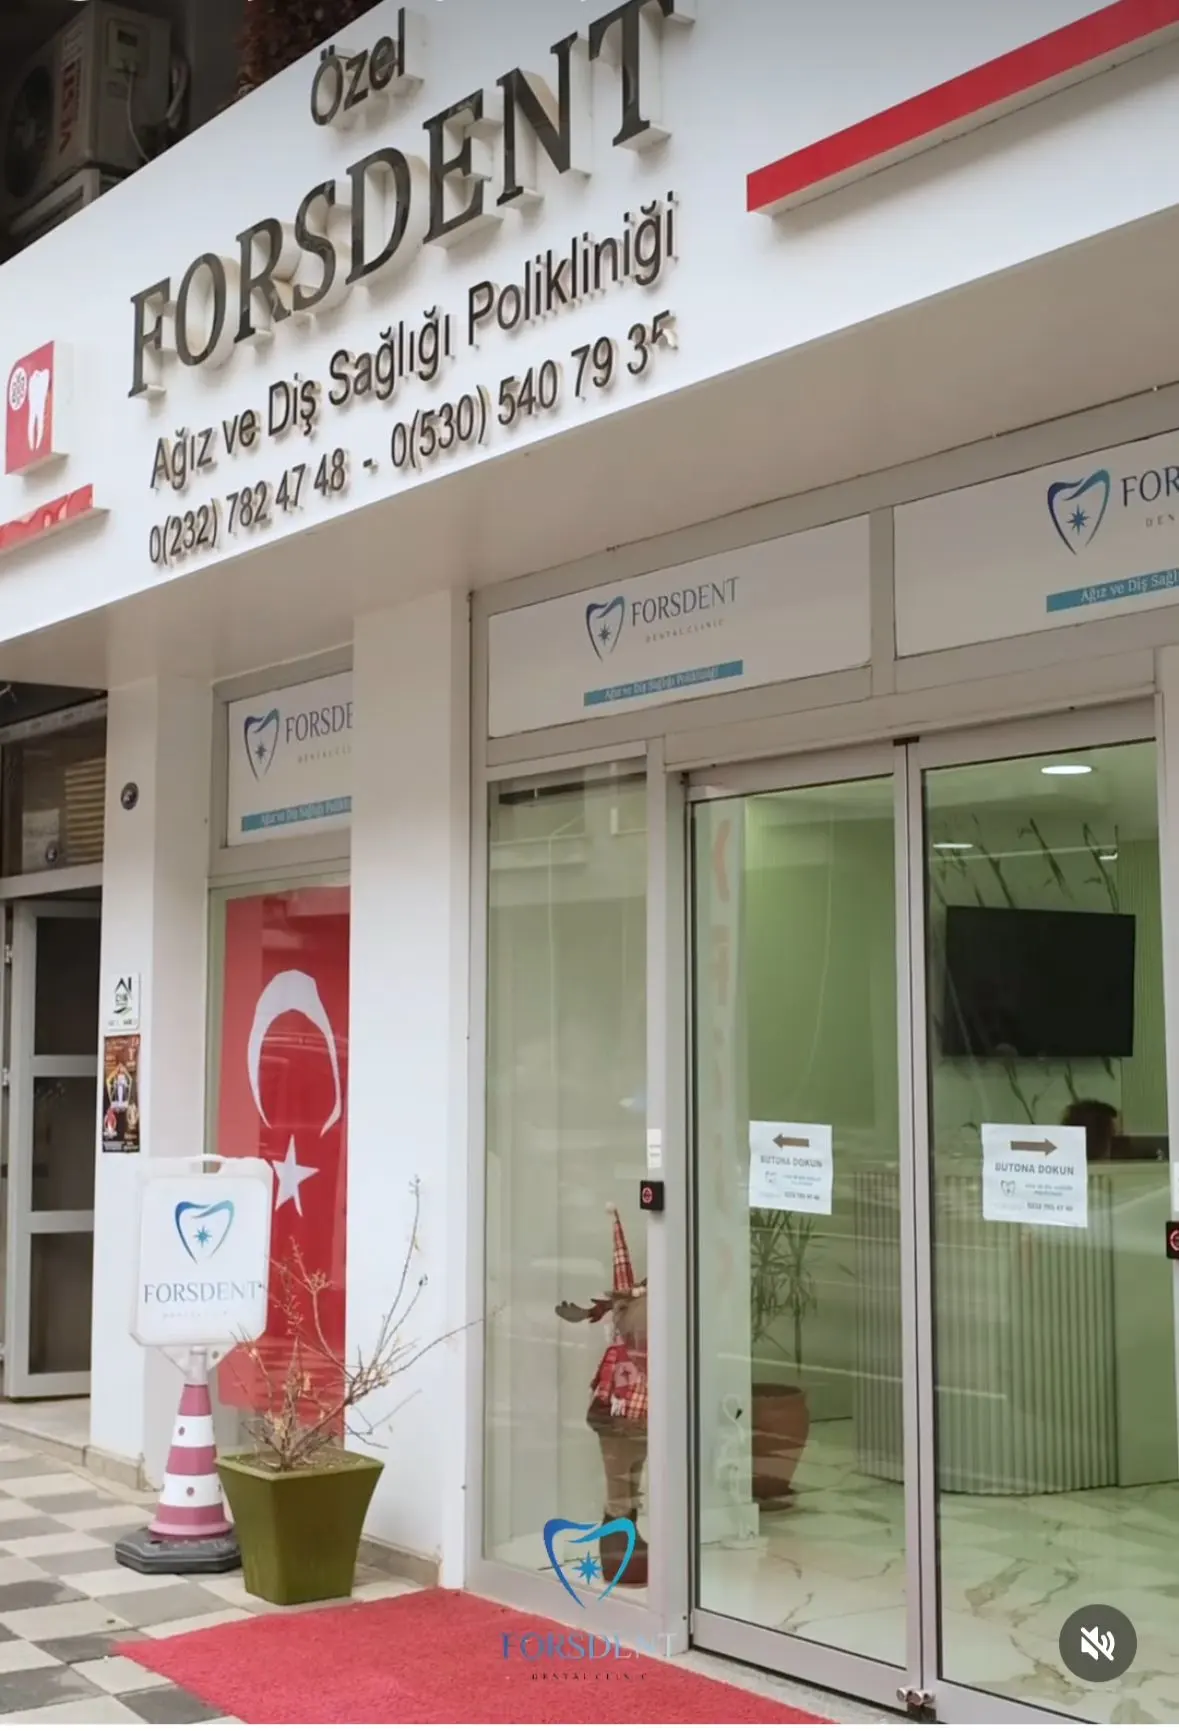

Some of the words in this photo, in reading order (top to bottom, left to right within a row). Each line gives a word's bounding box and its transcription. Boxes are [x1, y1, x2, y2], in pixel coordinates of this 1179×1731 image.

[311, 7, 405, 126] Özel
[128, 0, 675, 398] FORSDENT
[150, 426, 213, 490] Ağız
[222, 409, 257, 454] ve
[268, 372, 317, 435] Diş
[329, 305, 450, 406] Sağlığı
[469, 191, 674, 346] Polikliniği
[149, 498, 218, 565] 0(232)
[226, 480, 268, 534] 782
[275, 463, 307, 511] 47
[314, 448, 346, 496] 48
[391, 384, 487, 469] 0(530)
[497, 367, 559, 426] 540
[571, 336, 614, 397] 79
[1120, 465, 1179, 507] FOR
[631, 576, 740, 627] FORSDENT
[1037, 1164, 1075, 1176] DOKUN
[144, 1280, 259, 1304] FORSDENT
